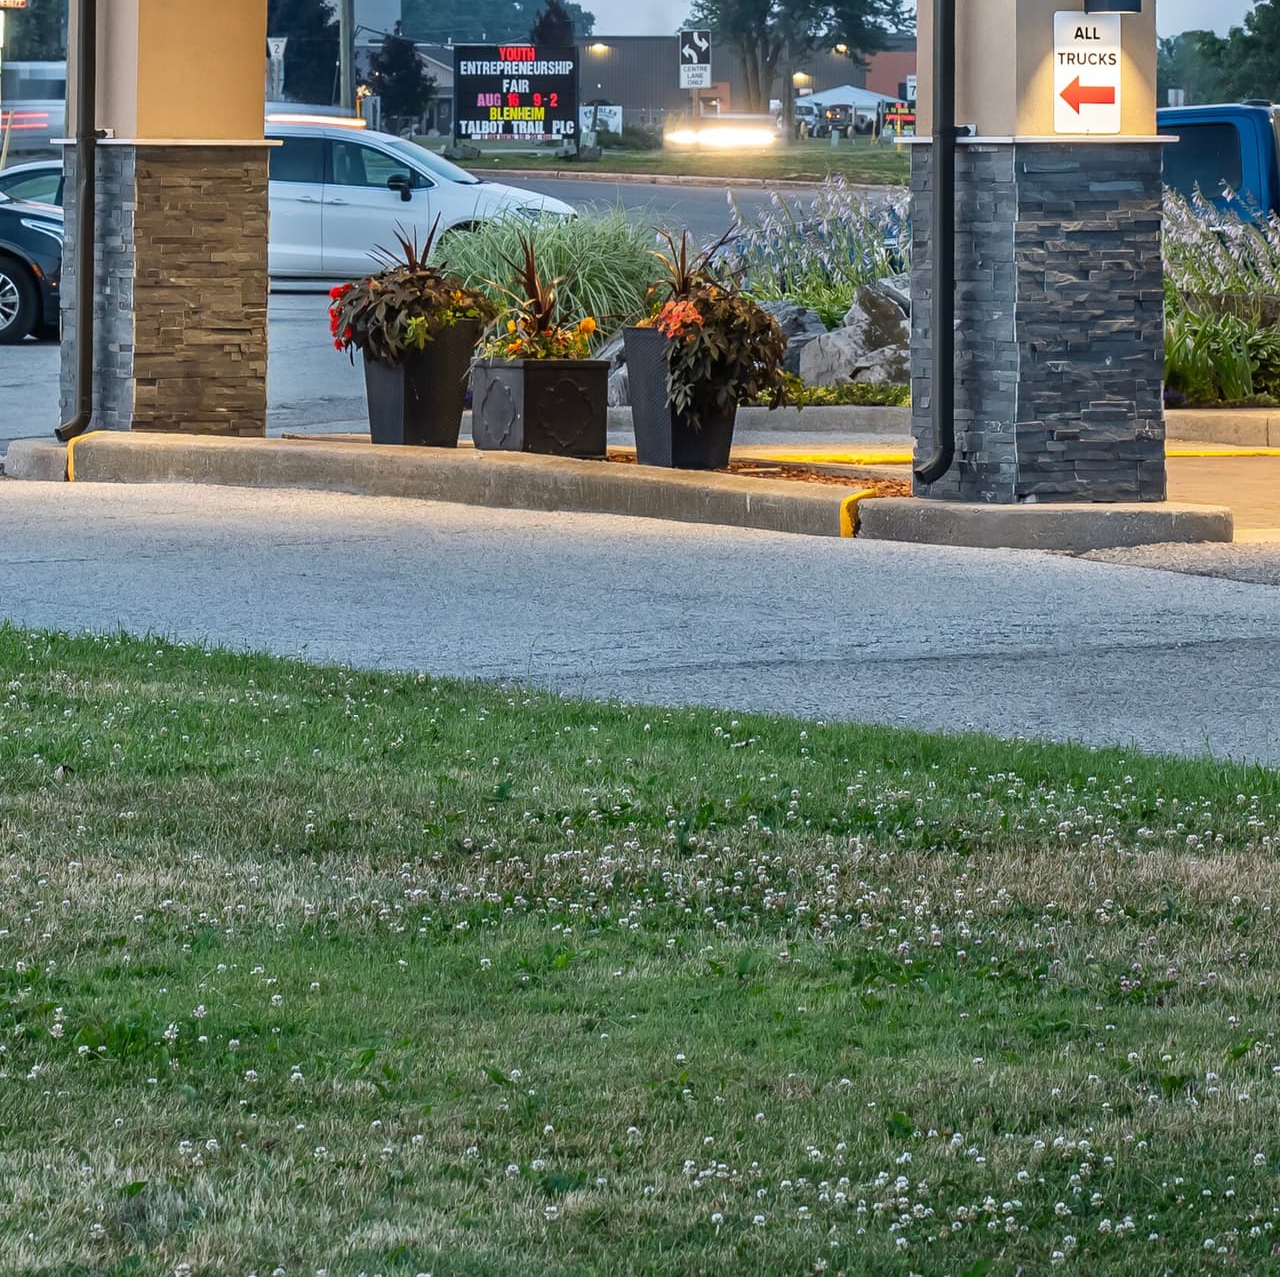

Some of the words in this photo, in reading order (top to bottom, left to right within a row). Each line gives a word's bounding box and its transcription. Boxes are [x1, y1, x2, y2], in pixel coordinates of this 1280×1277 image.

[1074, 26, 1101, 40] ALL
[499, 47, 536, 61] YOUTH
[1058, 52, 1117, 65] TRUCKS
[460, 61, 573, 75] ENTREPRENEURSHIP
[502, 79, 530, 93] FAIR
[477, 93, 501, 107] AUG
[507, 93, 519, 107] 16
[489, 106, 545, 120] BLENHEIM
[459, 120, 504, 134] TALBOT
[512, 120, 545, 134] TRAIL
[552, 120, 575, 134] PLC
